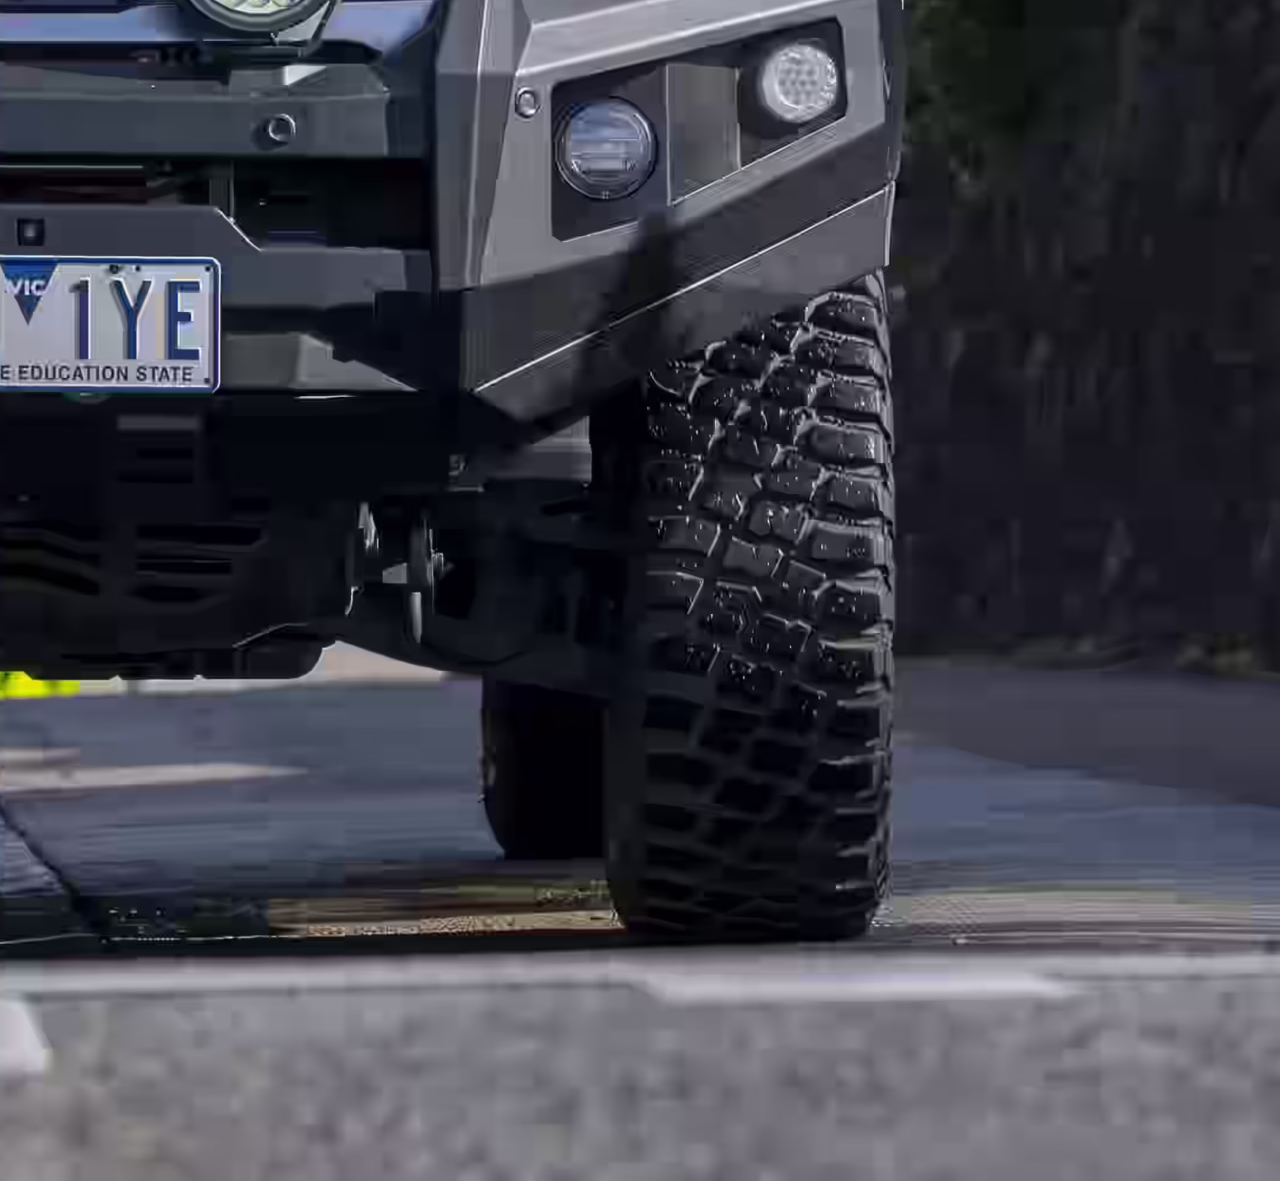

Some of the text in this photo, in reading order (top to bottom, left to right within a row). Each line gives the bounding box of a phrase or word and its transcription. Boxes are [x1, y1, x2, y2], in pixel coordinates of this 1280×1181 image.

[6, 278, 45, 295] VIC
[68, 277, 201, 360] 1YE
[19, 365, 128, 381] EDUCATION
[136, 366, 193, 382] STATE
